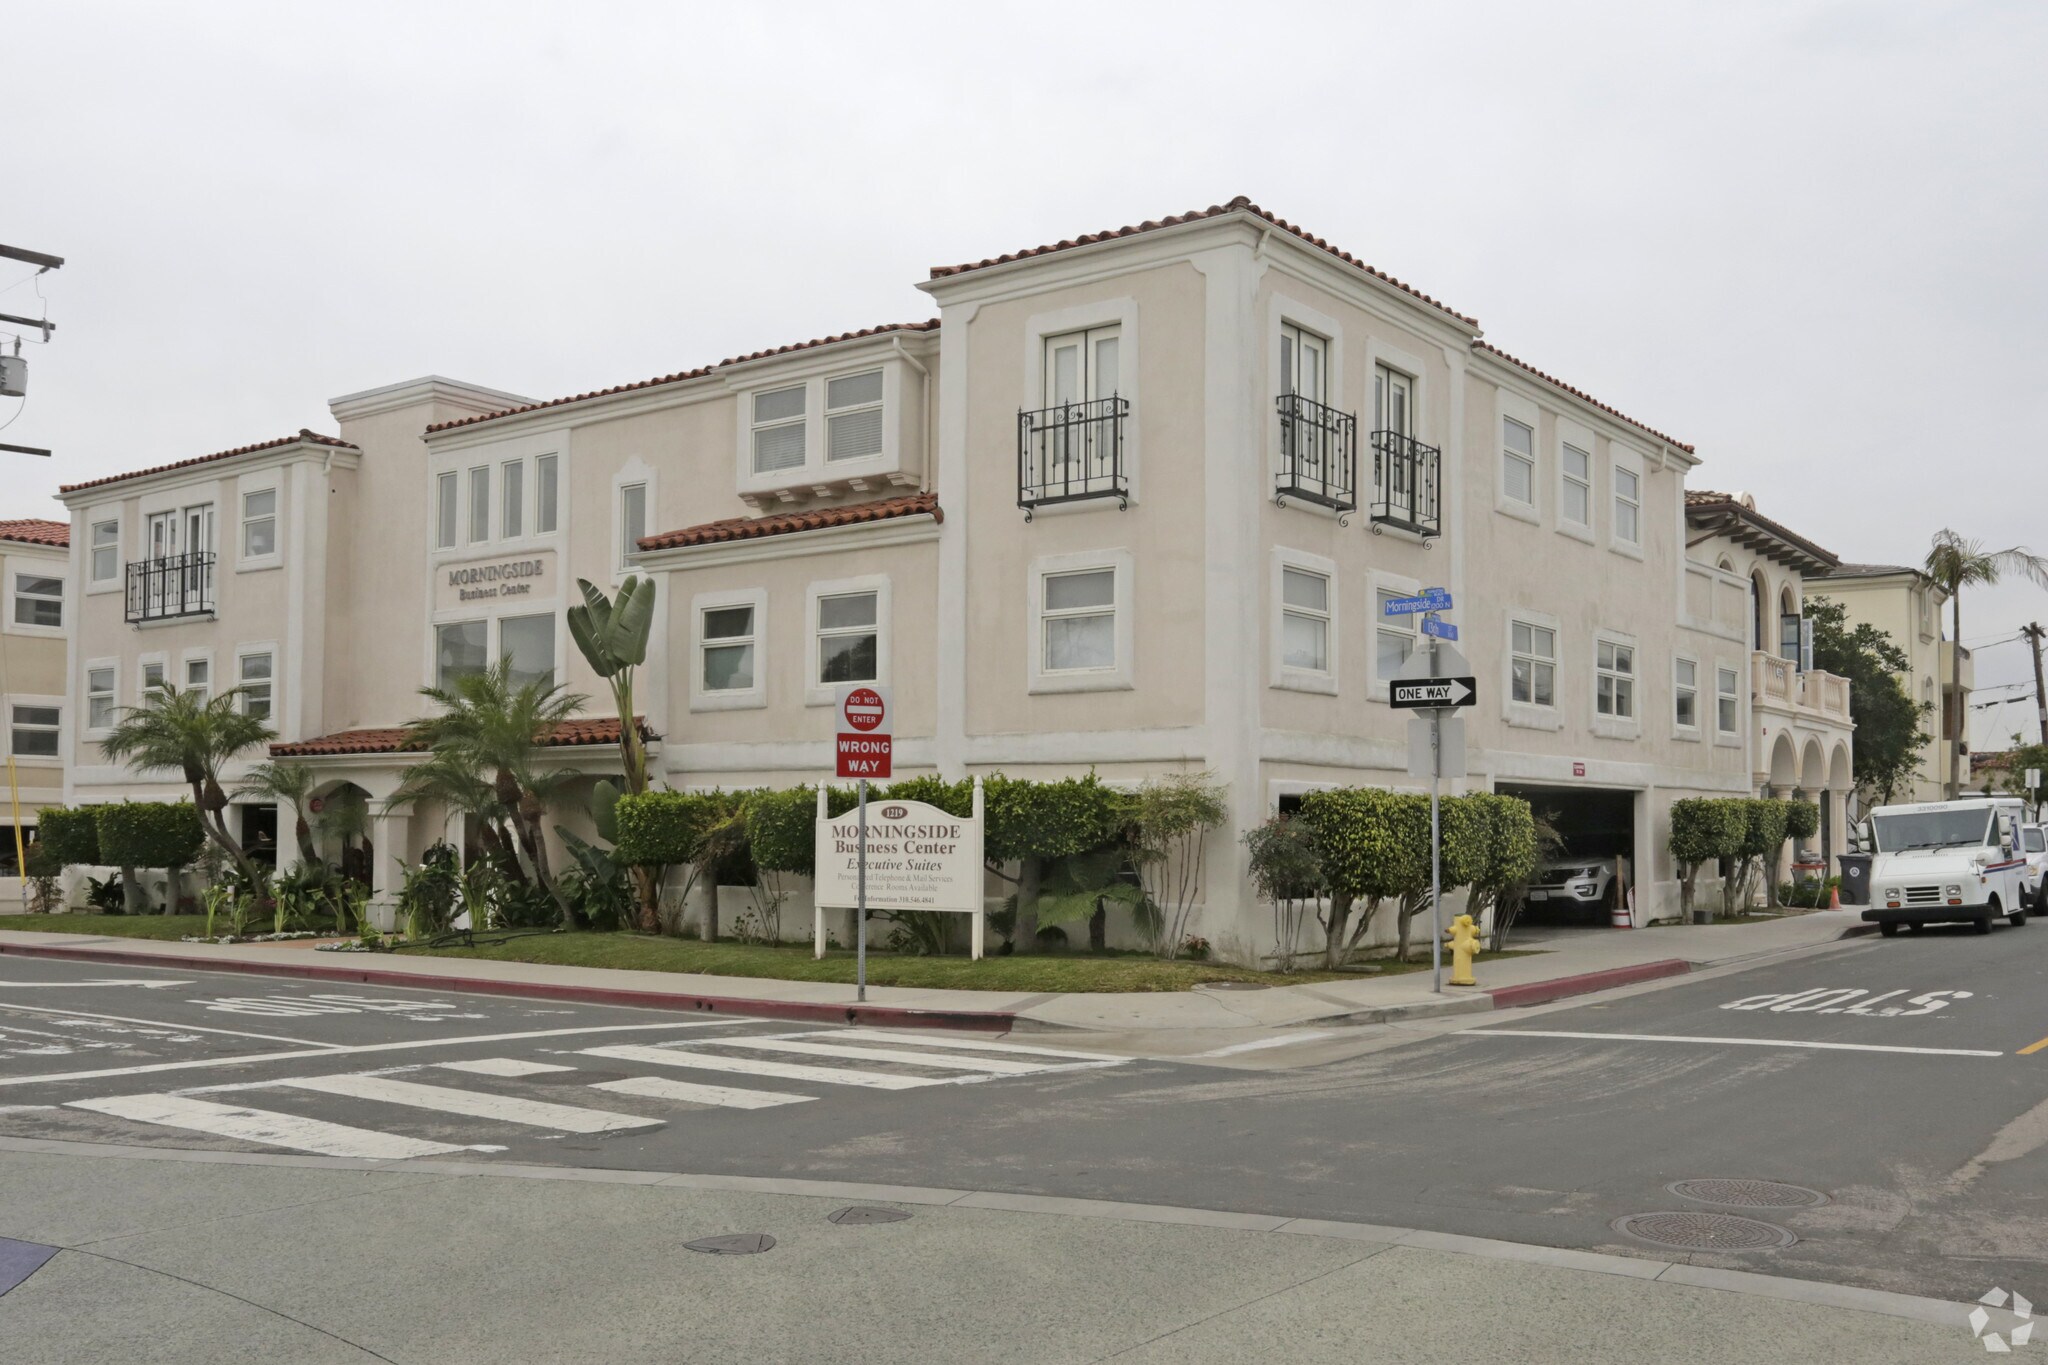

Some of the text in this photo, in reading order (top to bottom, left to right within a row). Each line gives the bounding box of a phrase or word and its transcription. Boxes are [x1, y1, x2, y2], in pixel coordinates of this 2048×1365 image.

[449, 559, 543, 586] MORNINGSIDE
[459, 583, 531, 601] Business Center
[1386, 598, 1431, 613] Morningside
[850, 696, 879, 704] DO NOT
[1398, 686, 1451, 700] ONE WAY
[852, 715, 876, 723] ENTER
[839, 741, 890, 754] WRONG
[848, 760, 880, 772] WAY
[886, 808, 904, 817] 1219
[835, 840, 956, 854] Busness Center
[847, 857, 942, 871] Eecutive Suites
